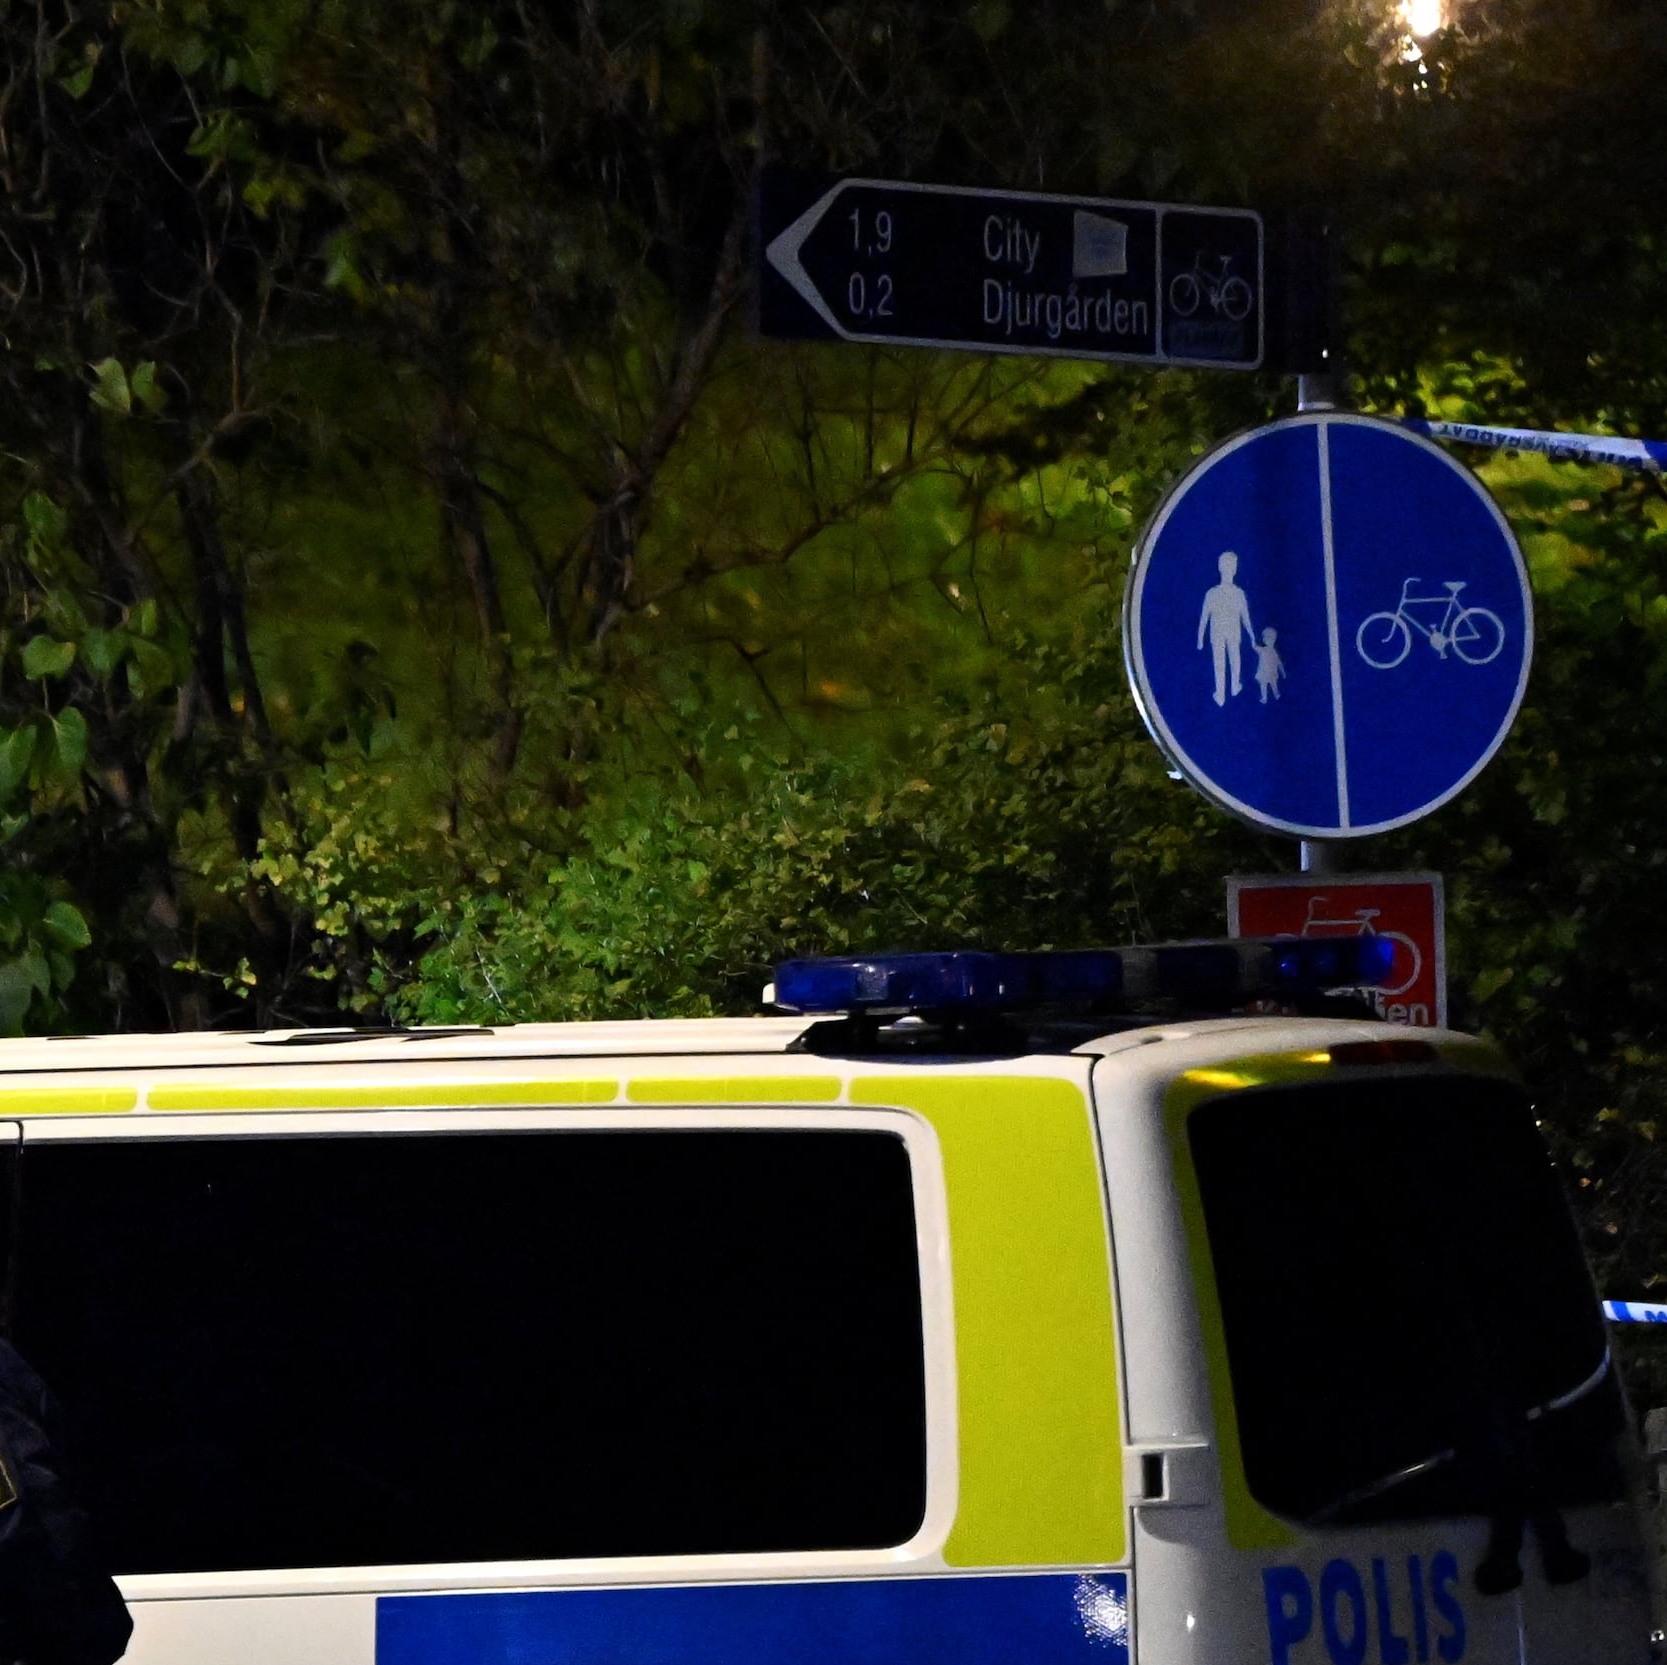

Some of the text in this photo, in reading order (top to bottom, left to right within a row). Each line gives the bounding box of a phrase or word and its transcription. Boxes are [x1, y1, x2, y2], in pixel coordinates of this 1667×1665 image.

[849, 208, 1041, 274] 1,9 City
[848, 271, 1149, 339] 0,2 Djurgården
